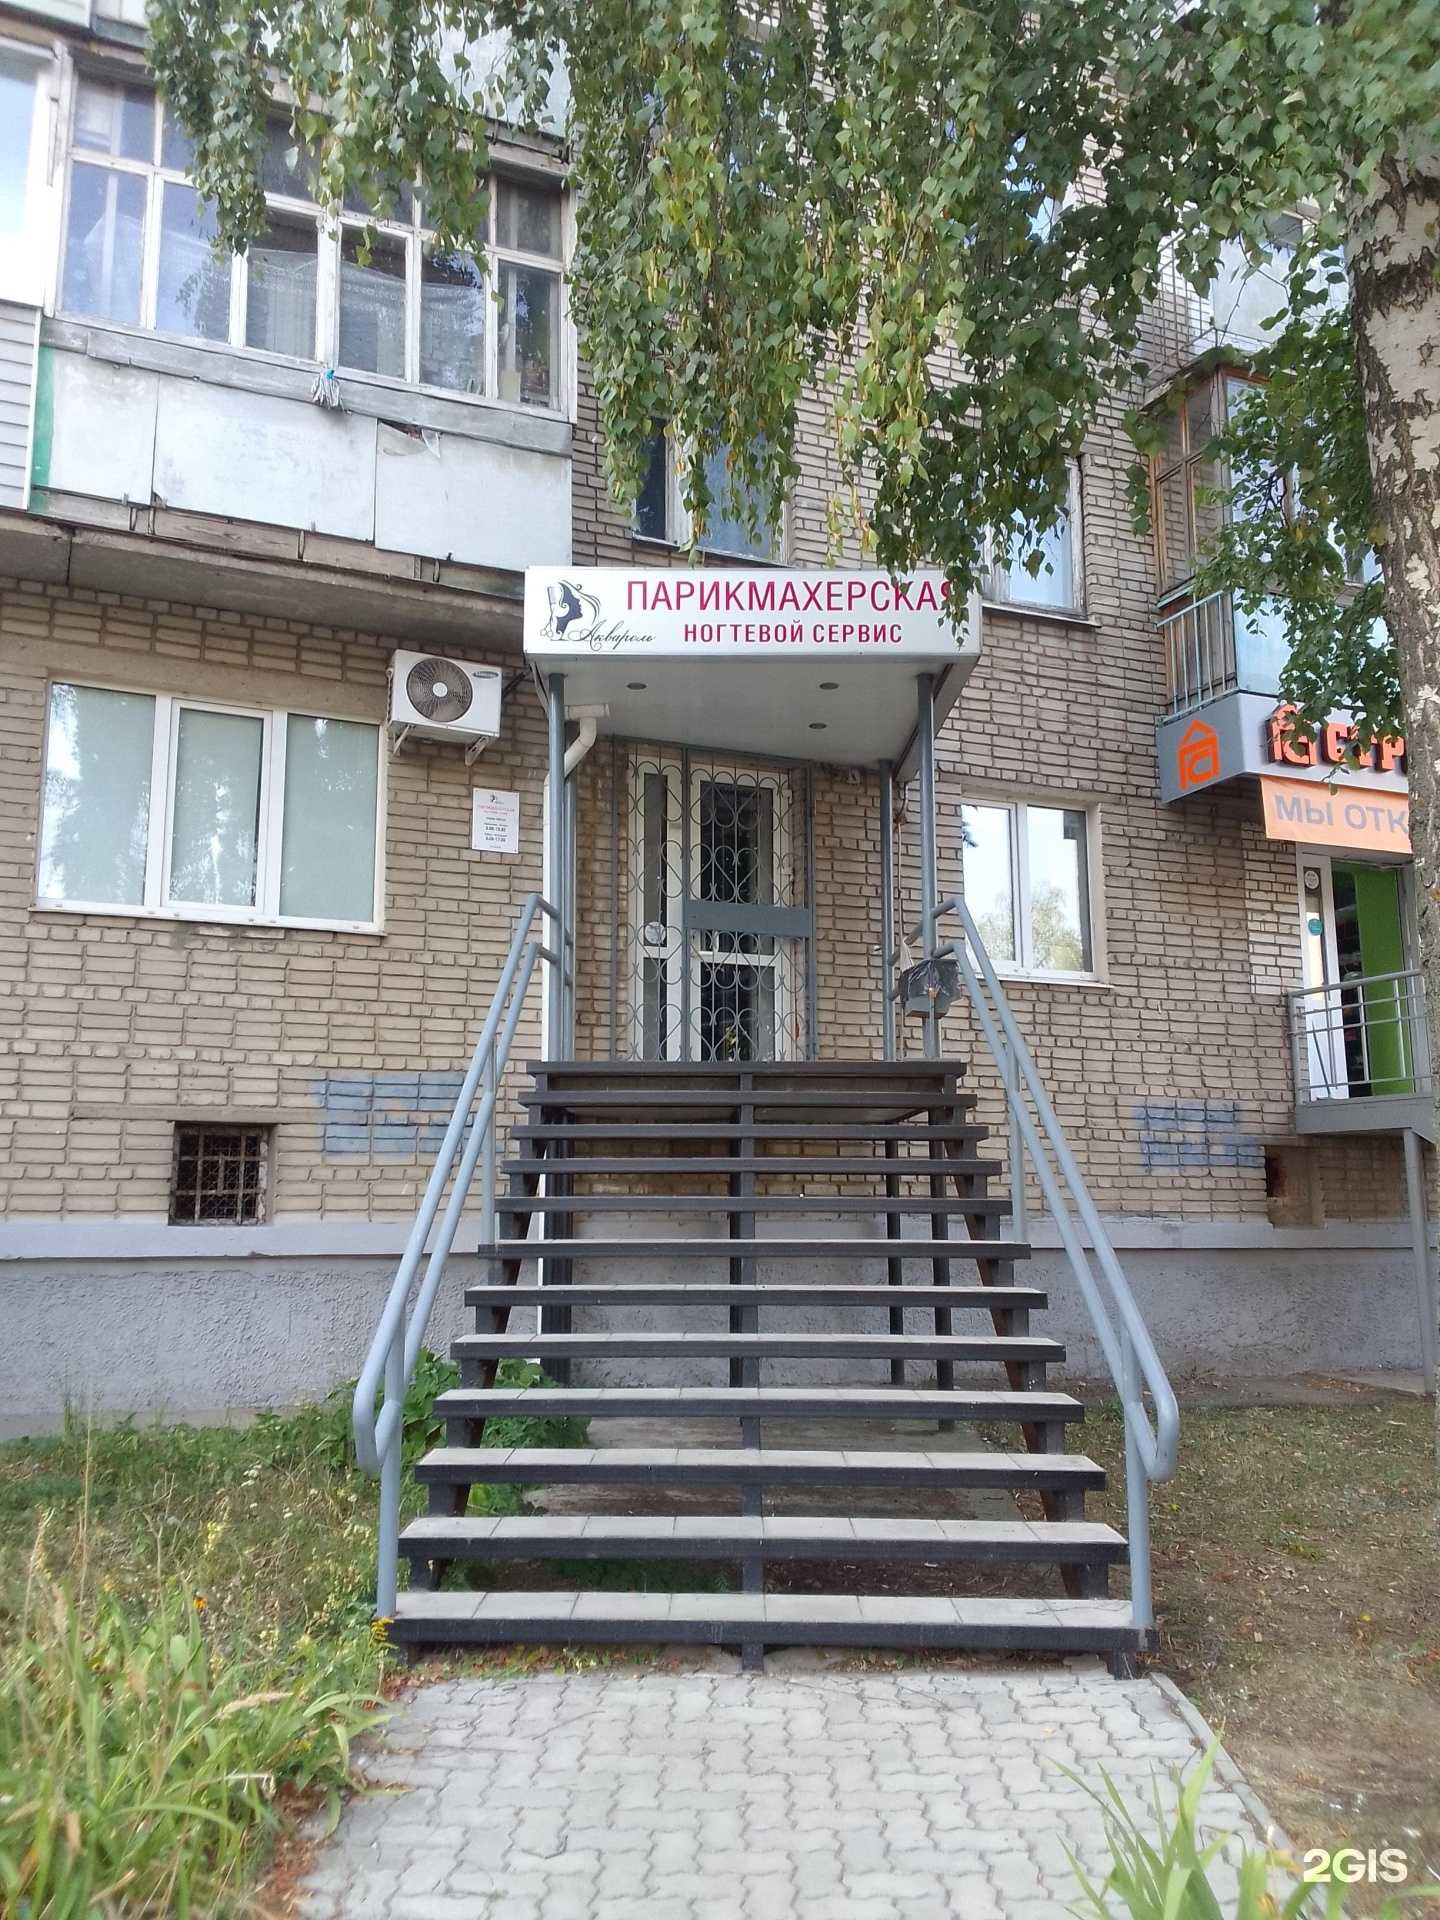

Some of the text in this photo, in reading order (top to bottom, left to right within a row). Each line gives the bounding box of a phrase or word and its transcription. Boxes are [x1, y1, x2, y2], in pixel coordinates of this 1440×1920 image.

[684, 619, 902, 643] НОГТЕВОЙ СЕРВИС
[1274, 794, 1334, 826] МЫ
